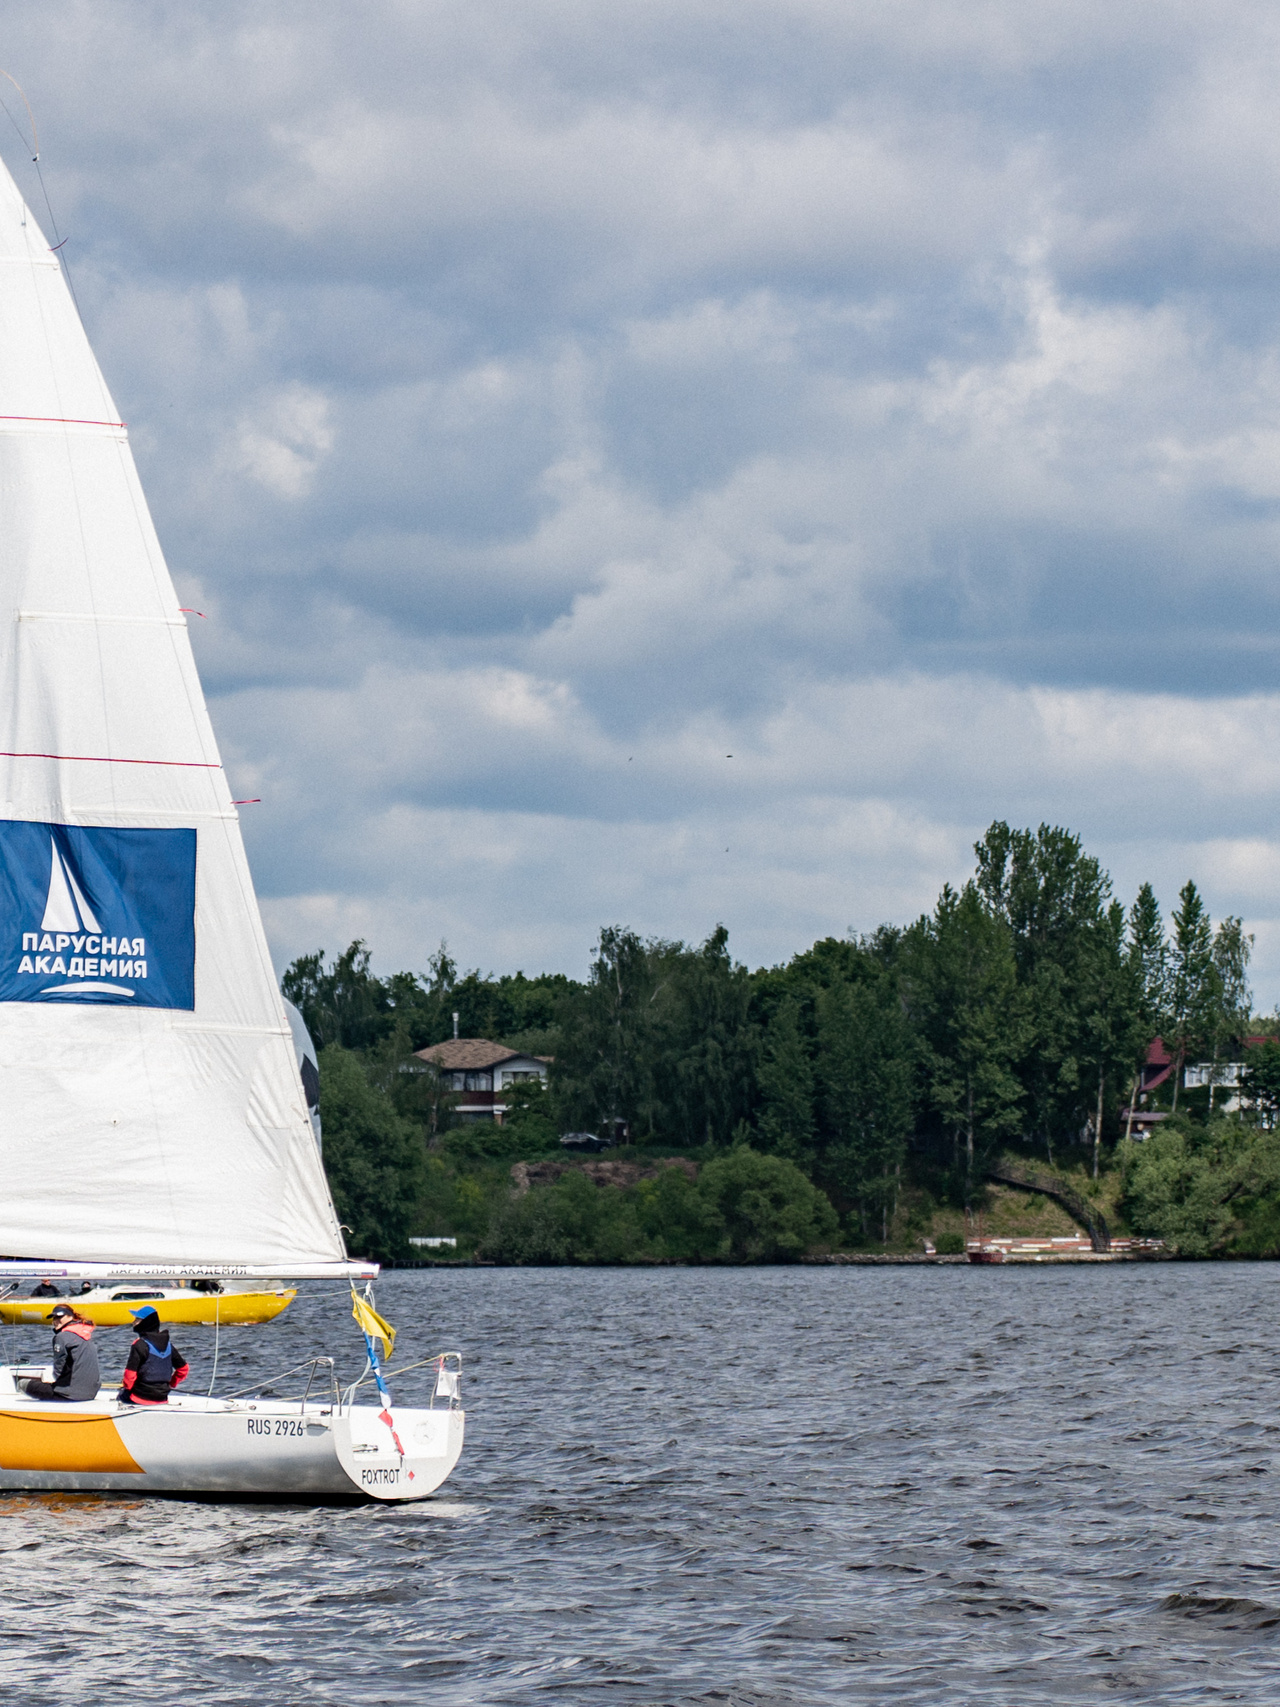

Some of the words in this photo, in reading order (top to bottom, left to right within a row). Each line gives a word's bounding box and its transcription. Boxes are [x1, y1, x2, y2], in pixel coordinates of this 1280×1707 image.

[22, 932, 145, 957] ПАРУСНАЯ
[17, 955, 148, 979] АКАДЕМИЯ
[247, 1418, 271, 1435] RUS
[275, 1420, 304, 1436] 2926
[361, 1468, 401, 1485] FOXTROT
